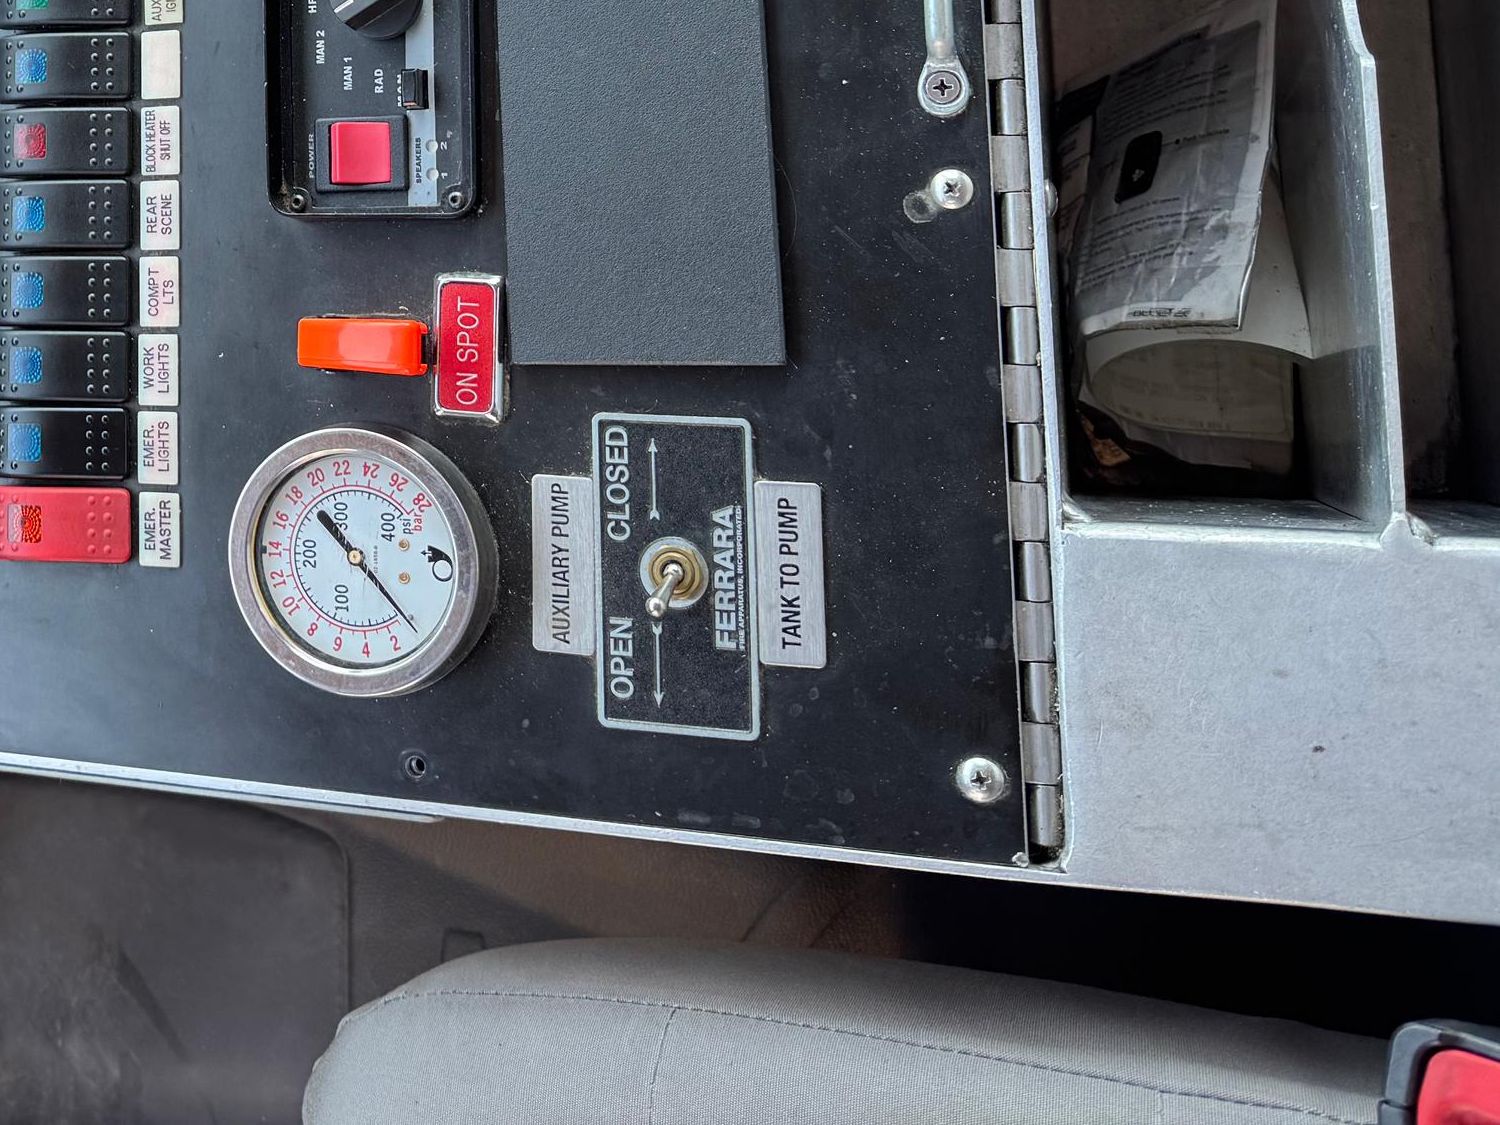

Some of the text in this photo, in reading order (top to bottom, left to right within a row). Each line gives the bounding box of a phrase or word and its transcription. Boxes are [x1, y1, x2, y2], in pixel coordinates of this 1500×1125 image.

[316, 39, 325, 65] MAN
[343, 65, 353, 91] MAN
[374, 68, 384, 94] RAD
[144, 110, 156, 174] BLOCK HEATER
[160, 119, 172, 161] SHUT OFF
[146, 195, 158, 234] REAR
[160, 193, 172, 236] SCENE
[147, 267, 160, 317] COMPT
[162, 279, 175, 306] LTS
[143, 346, 155, 390] WORK
[455, 295, 480, 406] ON SPOT
[158, 343, 170, 394] LIGHTS
[143, 424, 155, 468] EMER.
[158, 420, 170, 472] LIGHTS
[307, 468, 325, 487] 20
[332, 460, 351, 476] 22
[605, 426, 631, 542] CLOSED
[285, 485, 304, 506] 18
[144, 507, 156, 551] EMER.
[160, 499, 172, 561] MASTER
[272, 510, 289, 530] 16
[381, 512, 395, 543] 400
[400, 517, 414, 535] psi
[411, 512, 424, 532] bar
[268, 540, 283, 558] 14
[302, 539, 317, 569] 200
[550, 482, 571, 645] AUXILIARY PUMP
[270, 569, 287, 589] 12
[711, 505, 738, 650] FERRARA
[777, 497, 802, 650] TANK TO PUMP
[282, 596, 301, 616] 10
[334, 584, 349, 613] 100
[609, 617, 635, 699] OPEN
[737, 632, 746, 651] FIRE
